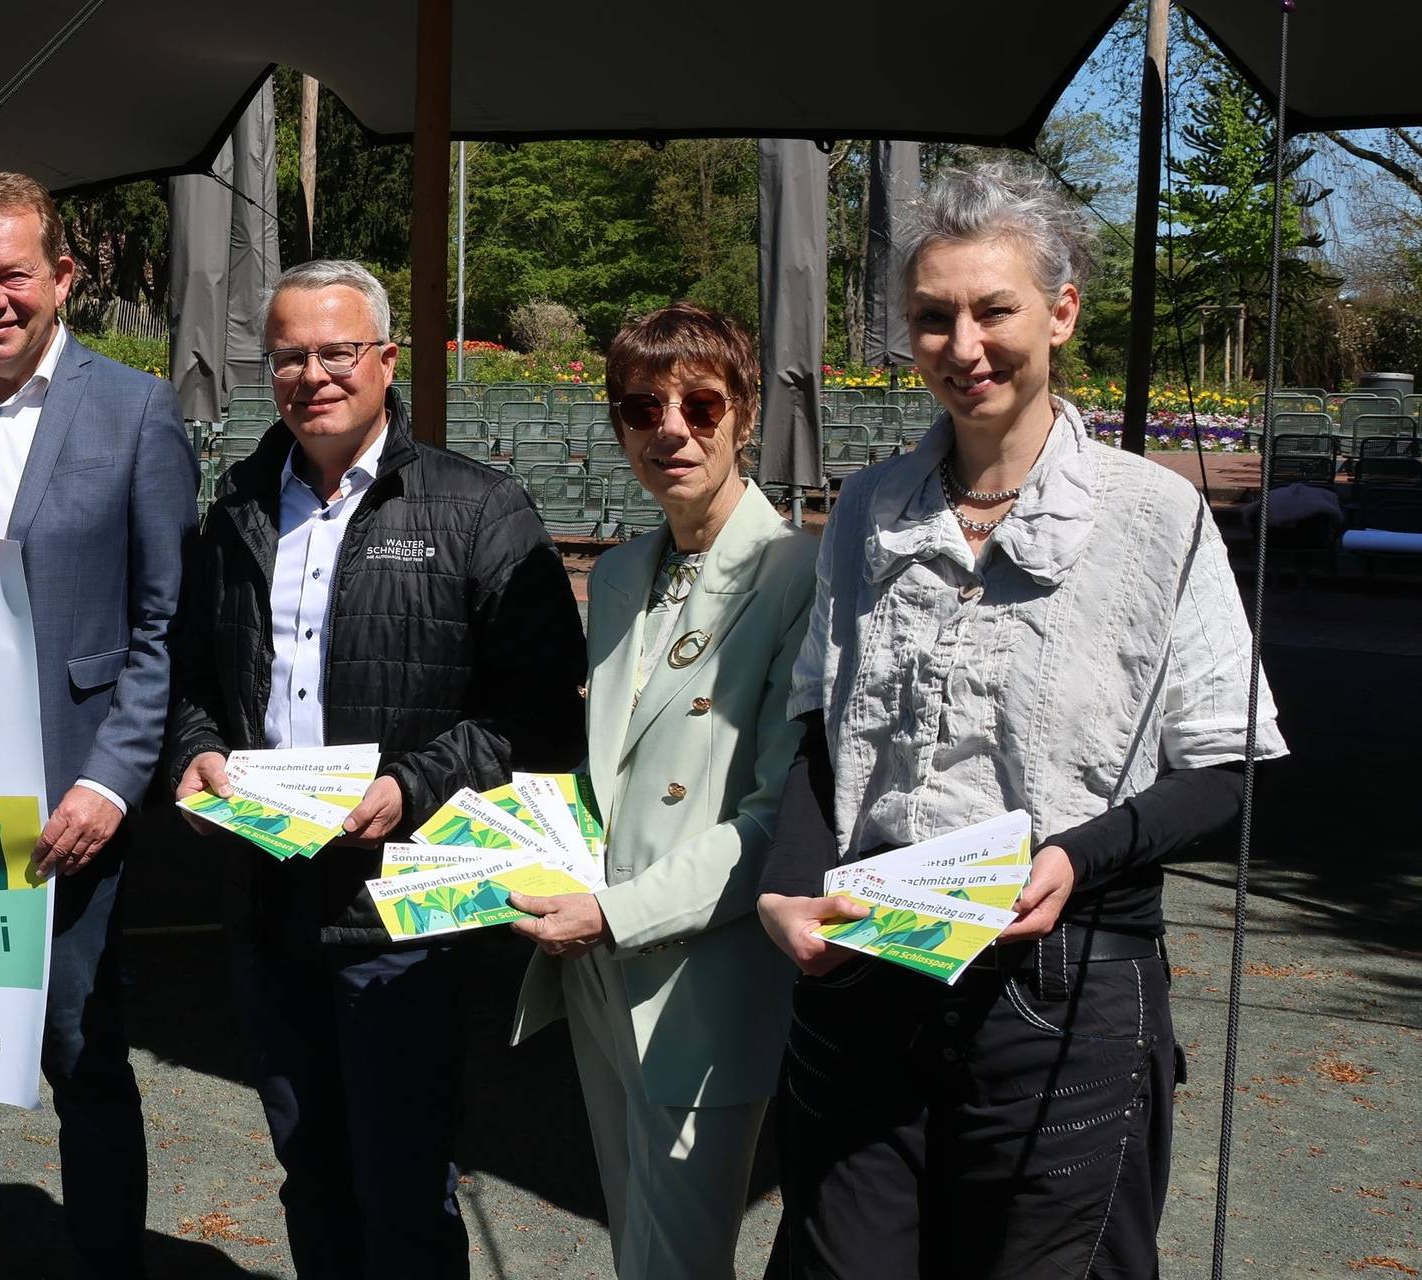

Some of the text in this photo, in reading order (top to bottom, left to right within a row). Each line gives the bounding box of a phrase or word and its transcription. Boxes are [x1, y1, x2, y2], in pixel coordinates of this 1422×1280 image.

[386, 538, 425, 548] WALTER
[366, 546, 424, 557] SCHNEIDER
[326, 763, 342, 771] um
[959, 852, 978, 862] um
[982, 848, 989, 856] 4
[379, 870, 485, 897] Sonntagnachmittag
[486, 864, 503, 873] um
[968, 875, 987, 883] um
[990, 873, 997, 882] 4
[859, 886, 985, 921] Sonntagnachmittag um 4
[899, 951, 955, 970] Schlosspark
